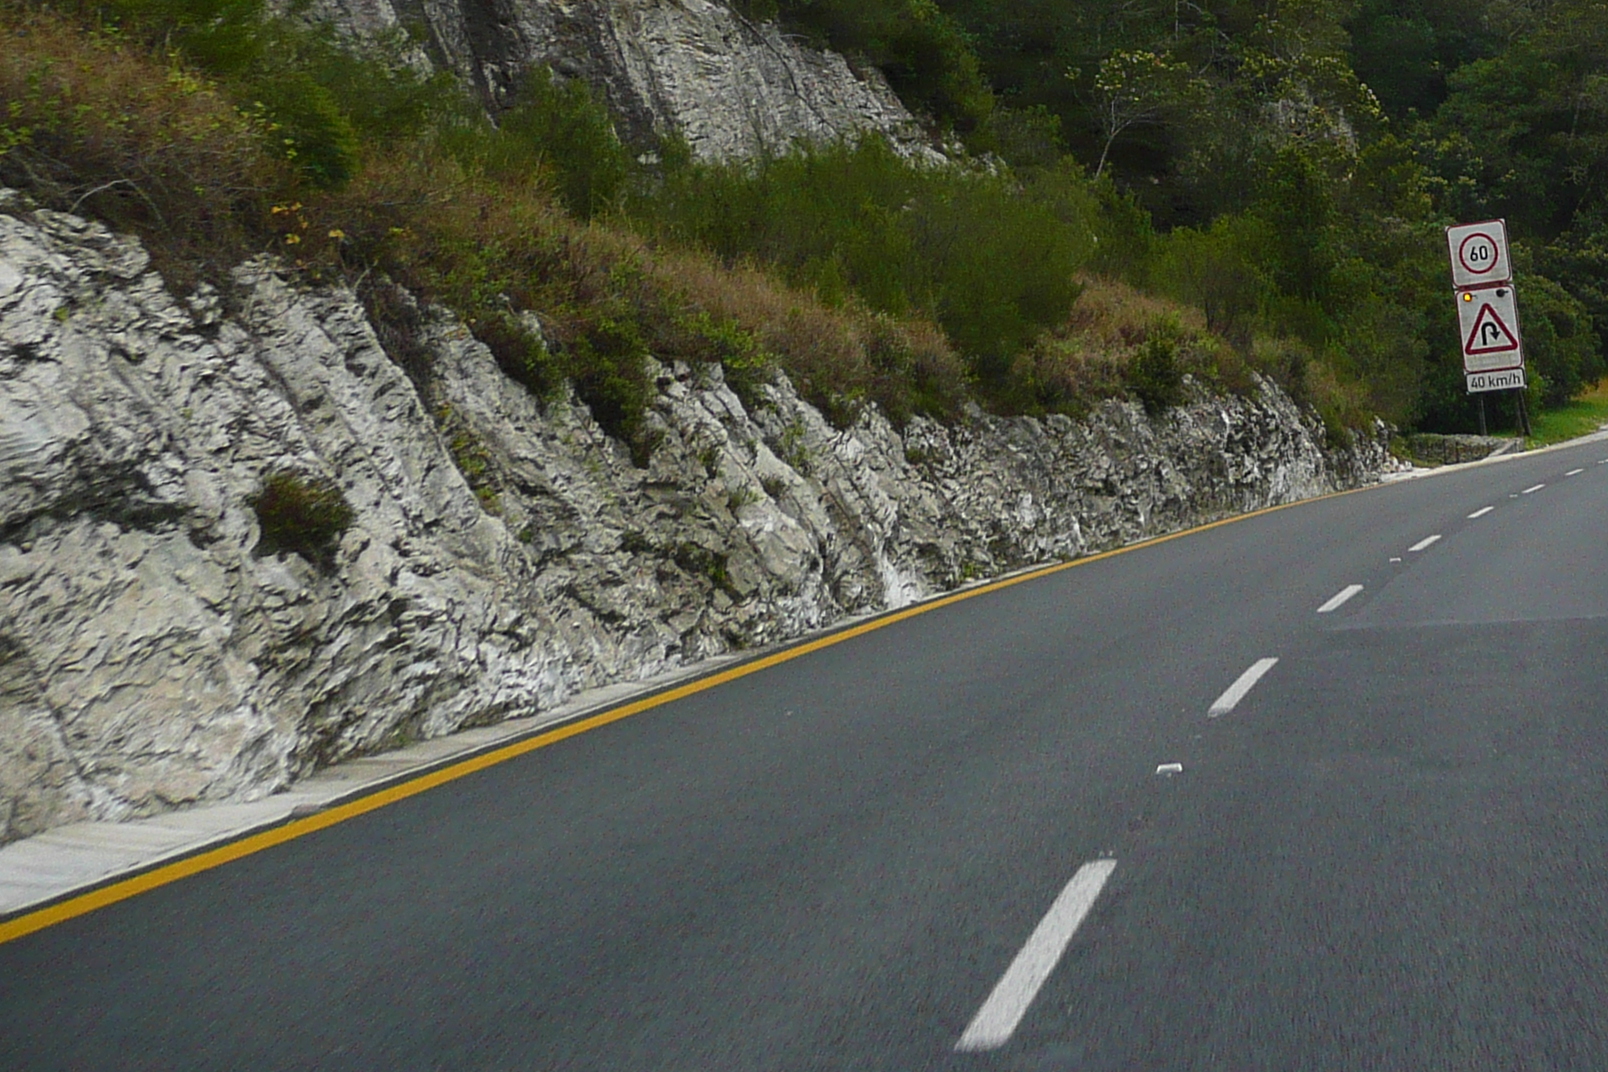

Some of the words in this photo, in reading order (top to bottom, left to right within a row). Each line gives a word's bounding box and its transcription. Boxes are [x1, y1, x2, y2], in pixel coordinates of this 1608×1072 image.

[1470, 245, 1488, 262] 60
[1471, 376, 1485, 389] 40
[1488, 373, 1521, 388] km/h
